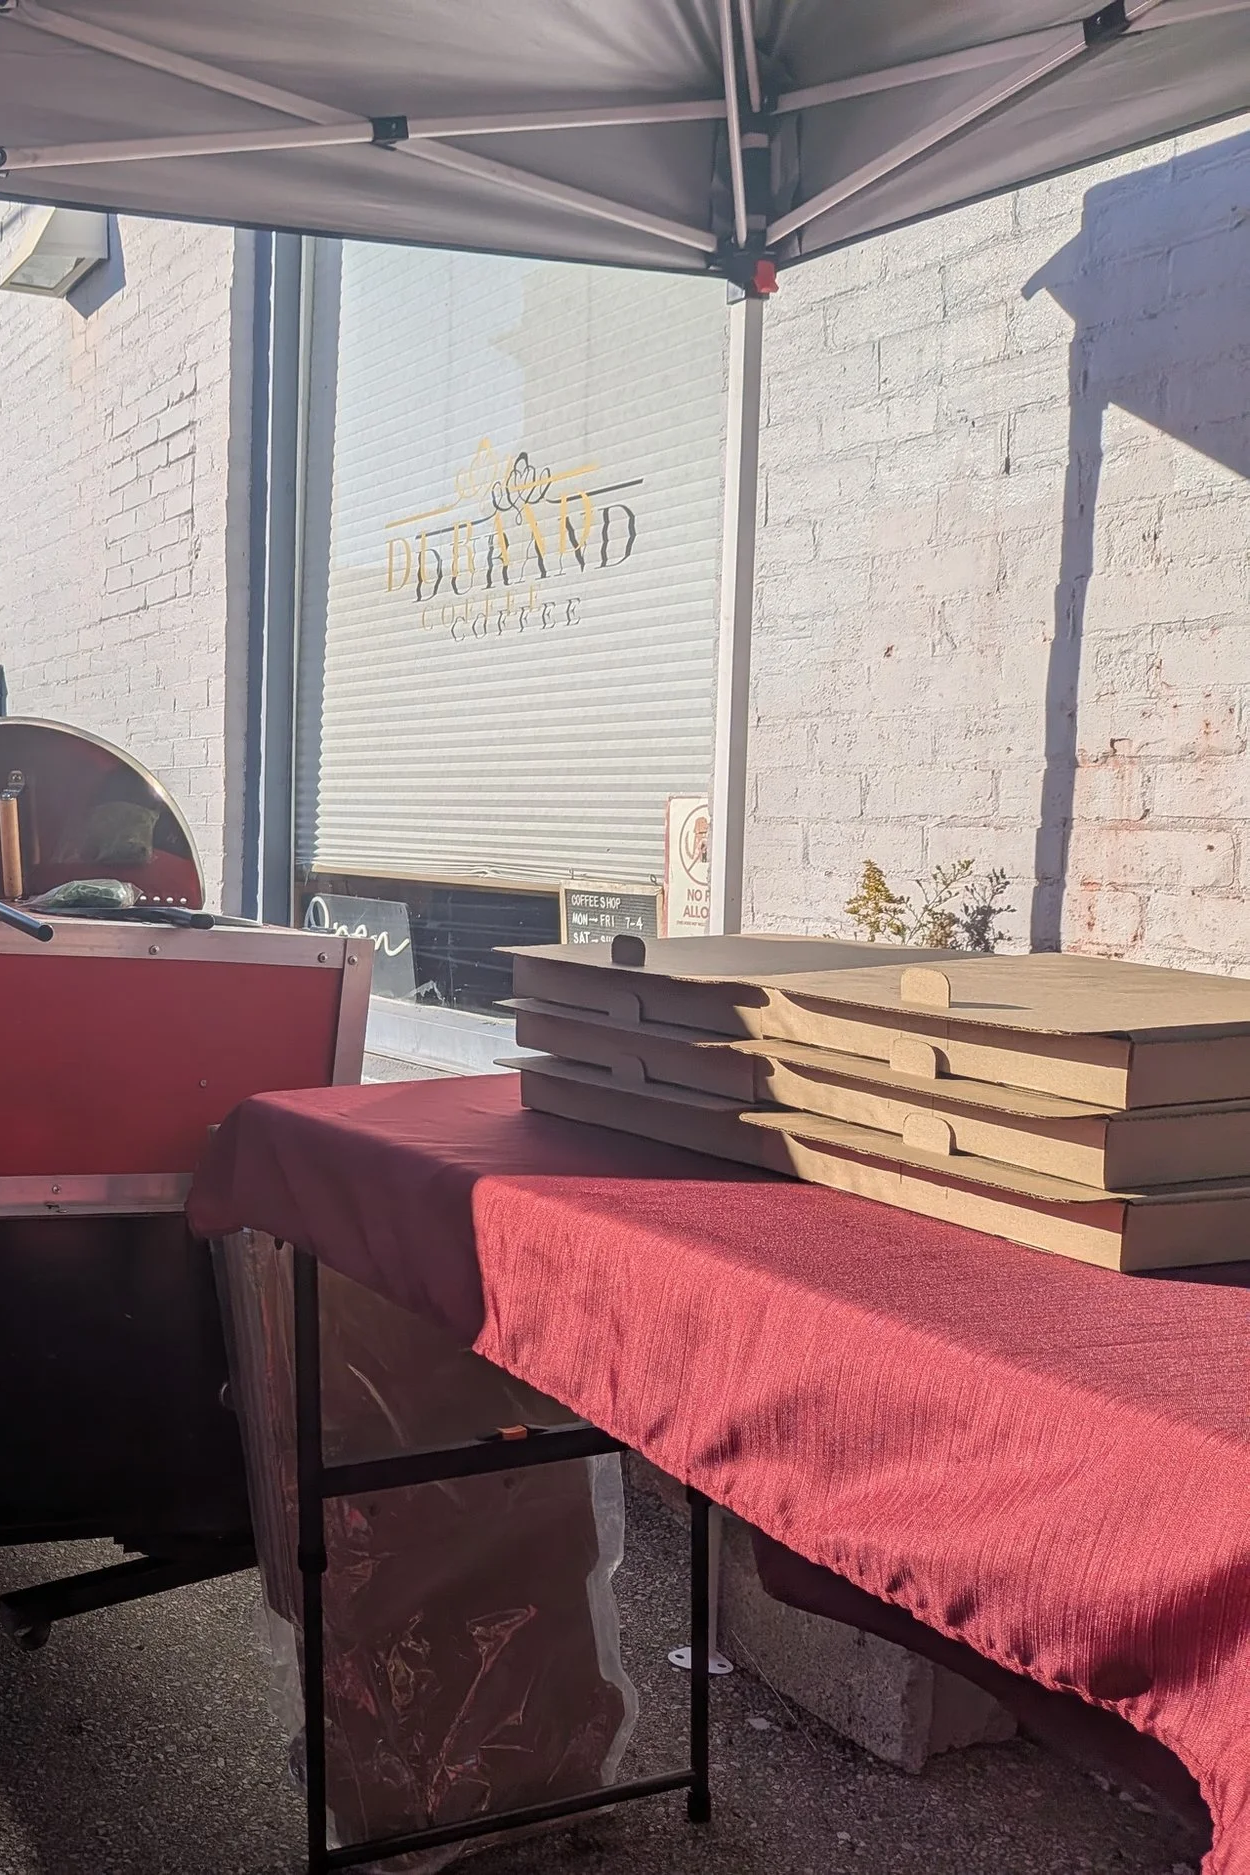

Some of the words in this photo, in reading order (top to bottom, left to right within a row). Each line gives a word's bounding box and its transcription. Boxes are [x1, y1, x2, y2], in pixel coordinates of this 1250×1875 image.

[451, 597, 581, 643] COFFEE
[571, 894, 599, 908] COFFEE
[599, 896, 621, 910] SHOP
[687, 889, 702, 901] NO
[683, 905, 709, 919] ALLO
[571, 912, 589, 926] MON
[599, 914, 615, 928] FRI
[625, 916, 644, 931] 7-4
[573, 931, 591, 944] SAT
